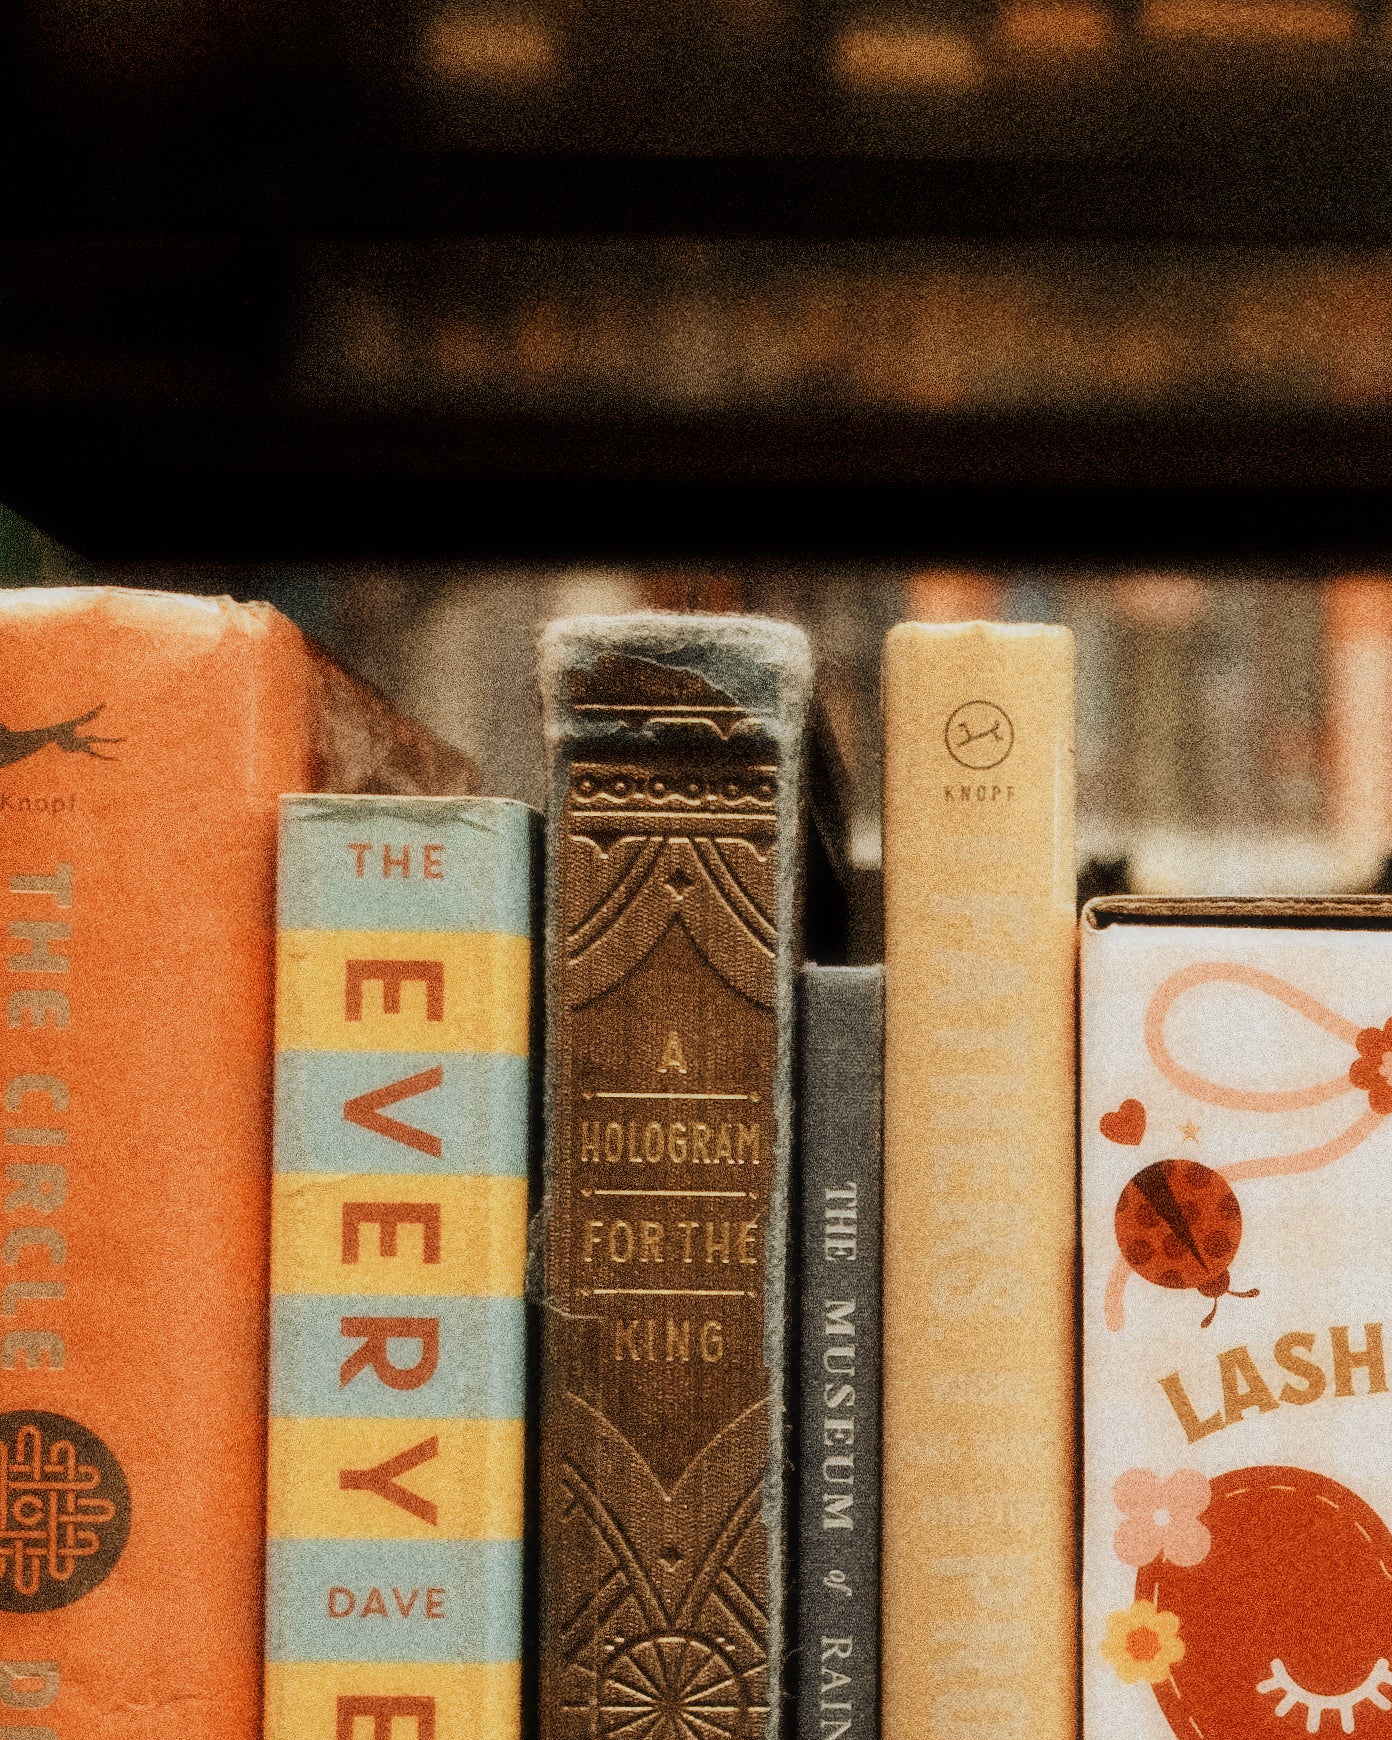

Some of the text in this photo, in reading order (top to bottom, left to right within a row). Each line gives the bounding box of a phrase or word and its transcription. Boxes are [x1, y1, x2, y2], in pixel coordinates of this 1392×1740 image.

[943, 784, 1017, 802] KNOPF
[347, 842, 446, 880] THE
[656, 1029, 688, 1074] A
[2, 861, 74, 1373] THE CIRCLE
[579, 1120, 761, 1165] HOLOGRAM
[338, 958, 446, 1527] EVERY
[583, 1220, 759, 1265] FOR THE
[823, 1182, 859, 1263] THE
[611, 1318, 726, 1363] KING
[1157, 1321, 1392, 1445] LASH
[820, 1297, 858, 1531] MUSEUM
[327, 1587, 447, 1619] DAVE
